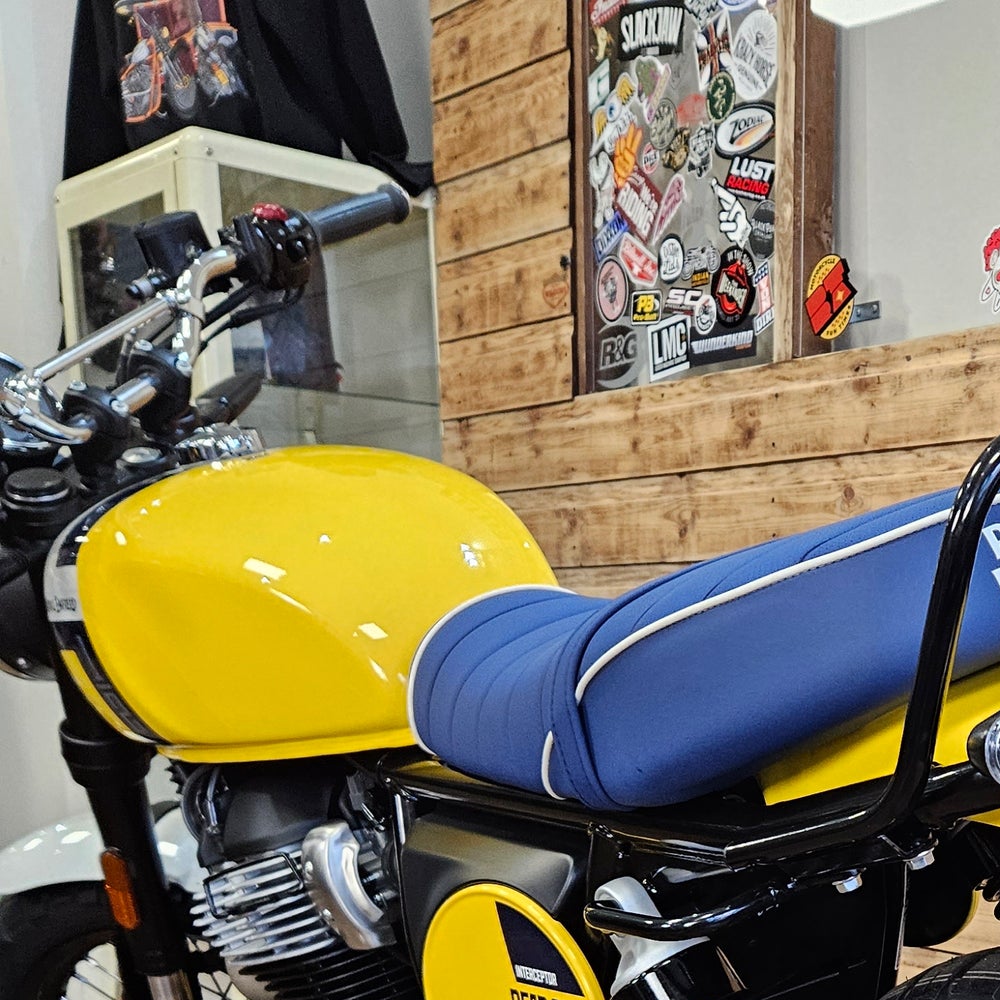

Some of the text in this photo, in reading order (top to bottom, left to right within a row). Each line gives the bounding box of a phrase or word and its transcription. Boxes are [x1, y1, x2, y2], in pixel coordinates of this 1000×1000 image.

[620, 6, 683, 53] SLACKJAW
[729, 114, 766, 145] ZODIAC
[730, 156, 776, 182] LUST
[726, 174, 770, 195] RACING
[810, 258, 836, 290] MOTORCYCLE
[636, 295, 655, 312] PB
[838, 305, 851, 328] TIMES
[601, 331, 637, 367] R&G
[652, 321, 687, 365] LMC
[514, 964, 558, 986] INTERCEPTOR
